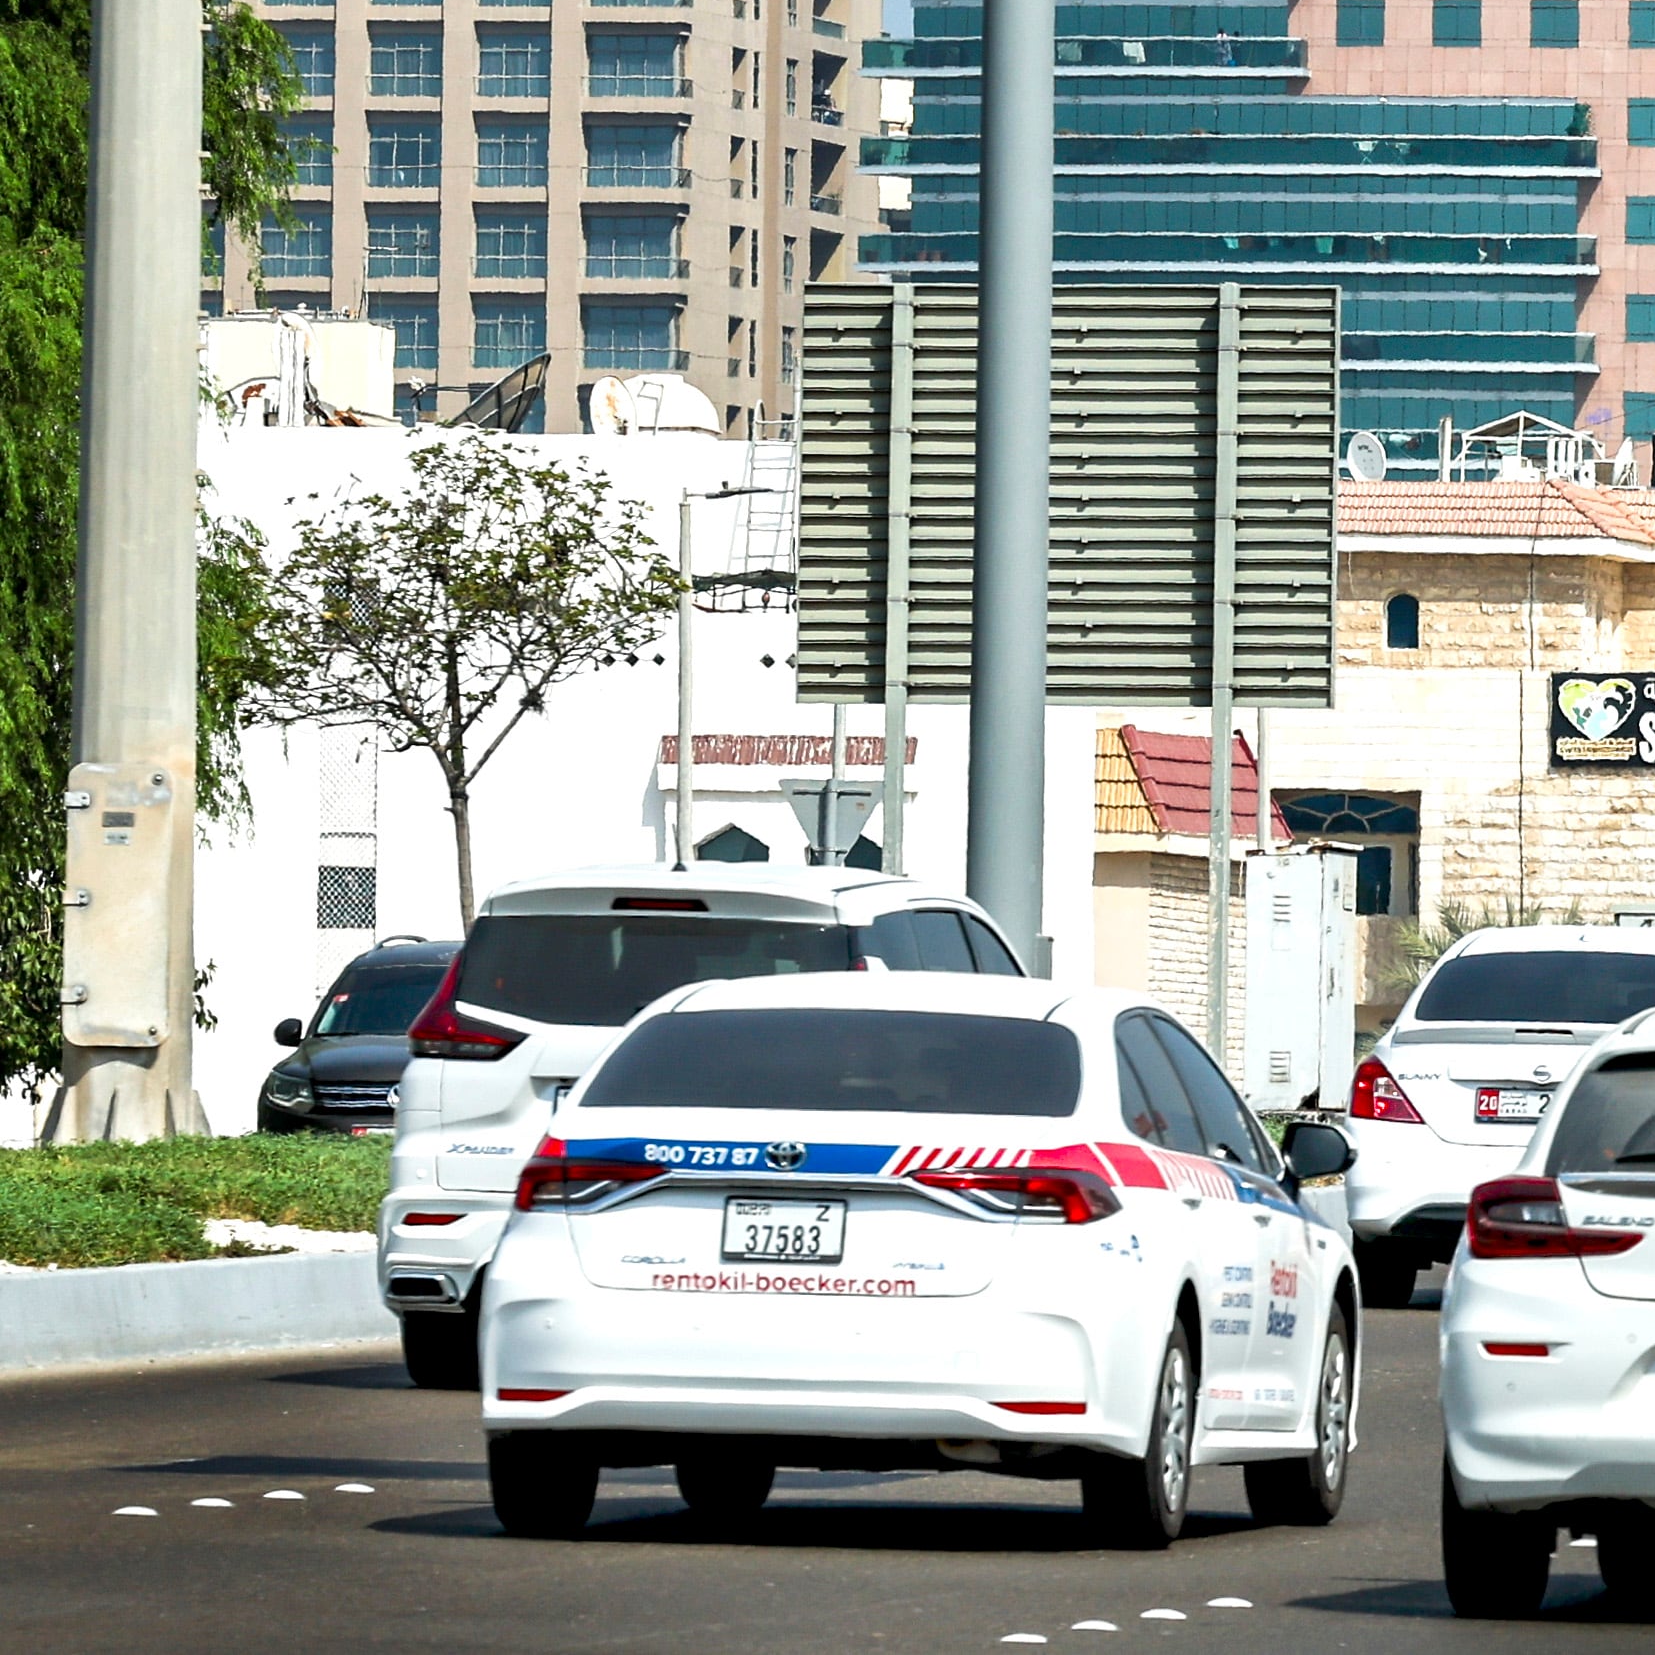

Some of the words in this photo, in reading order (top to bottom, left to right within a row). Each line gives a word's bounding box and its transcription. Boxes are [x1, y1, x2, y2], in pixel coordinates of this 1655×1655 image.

[1398, 1073, 1442, 1081] SUNNY
[644, 1143, 685, 1164] 800
[688, 1146, 728, 1165] 737
[731, 1146, 760, 1166] 87
[815, 1204, 831, 1222] Z
[744, 1224, 822, 1255] 37583
[651, 1271, 917, 1296] rentokil-boecker.com
